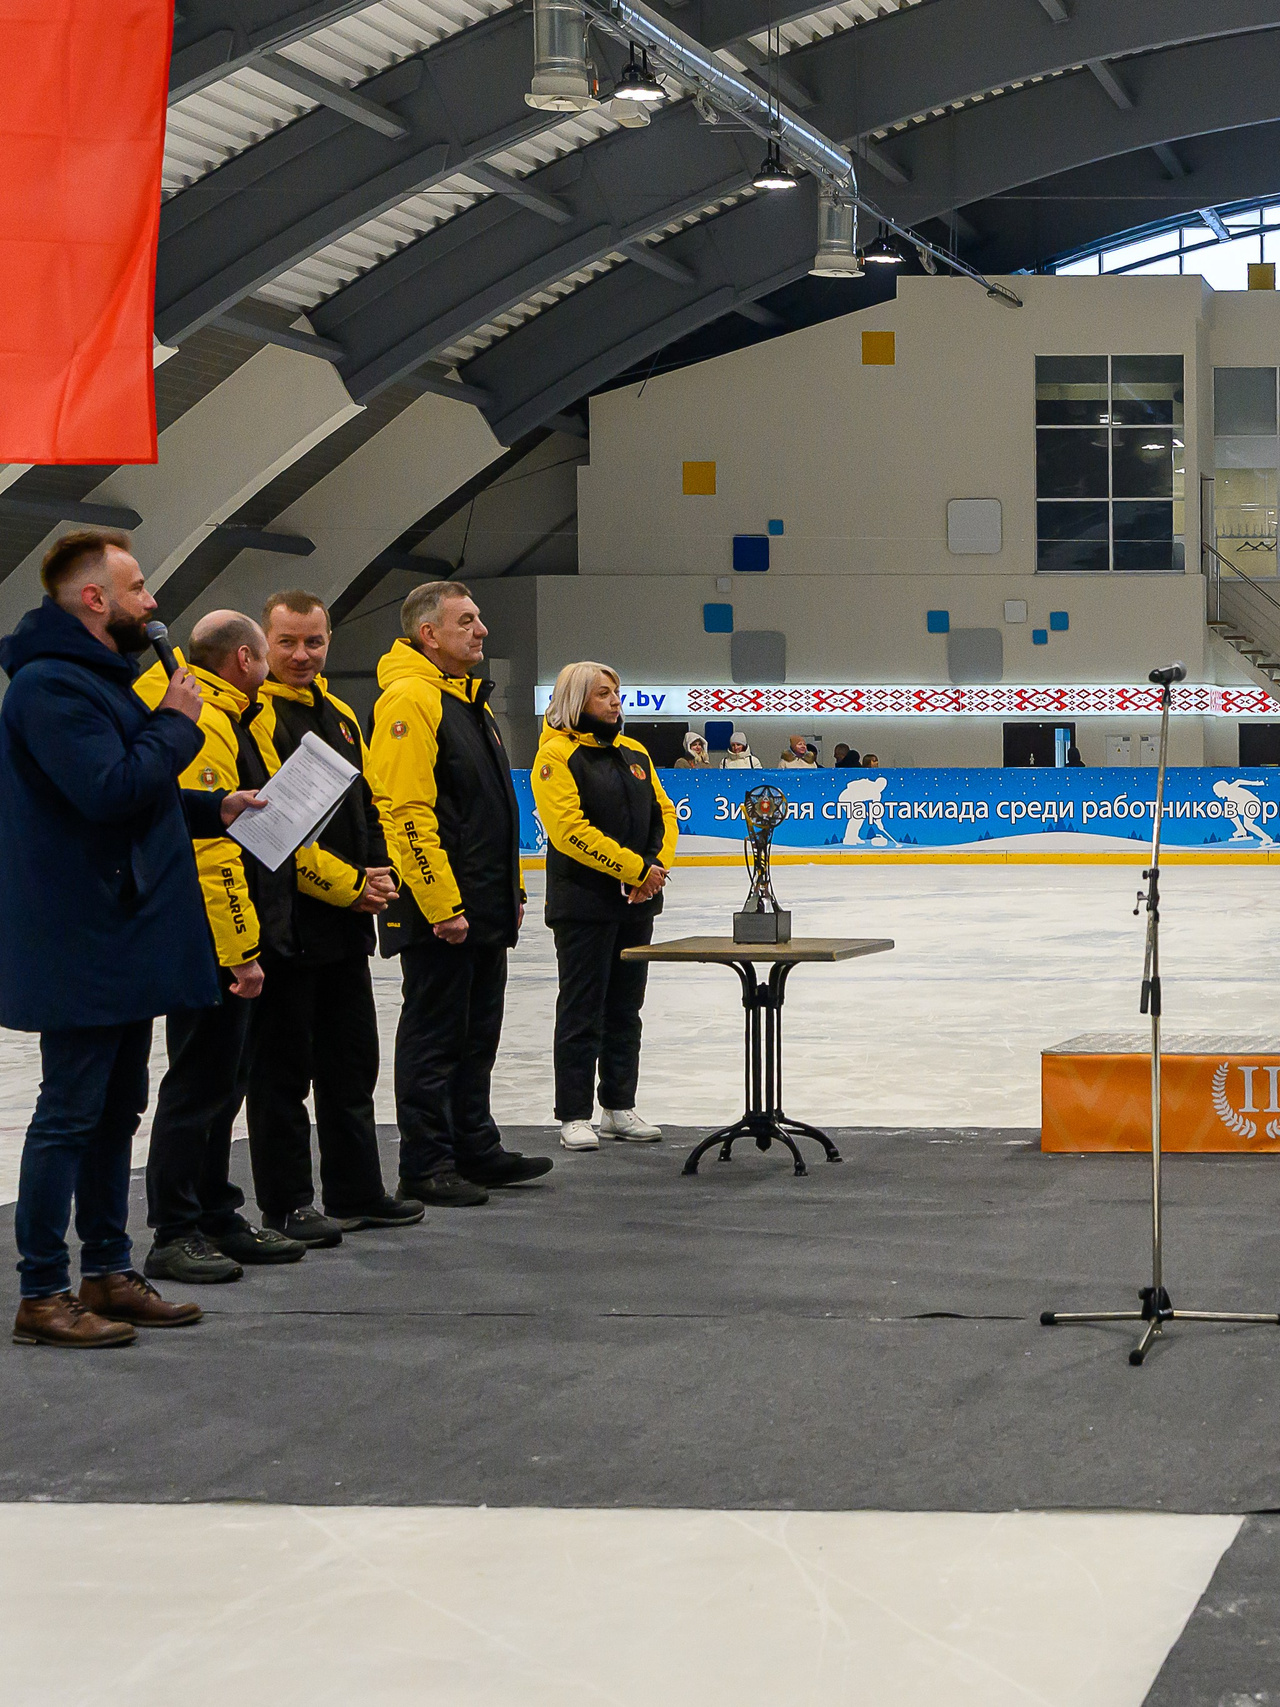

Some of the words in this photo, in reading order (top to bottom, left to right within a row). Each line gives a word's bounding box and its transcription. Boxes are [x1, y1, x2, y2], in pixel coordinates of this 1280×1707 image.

[714, 796, 814, 821] Зияя
[821, 801, 989, 824] спартакиада
[995, 801, 1076, 825] среди
[1082, 794, 1238, 825] работников
[404, 820, 436, 885] BELARUS
[568, 834, 624, 874] BELARUS
[298, 866, 333, 892] ARUS
[221, 867, 247, 935] BELARUS
